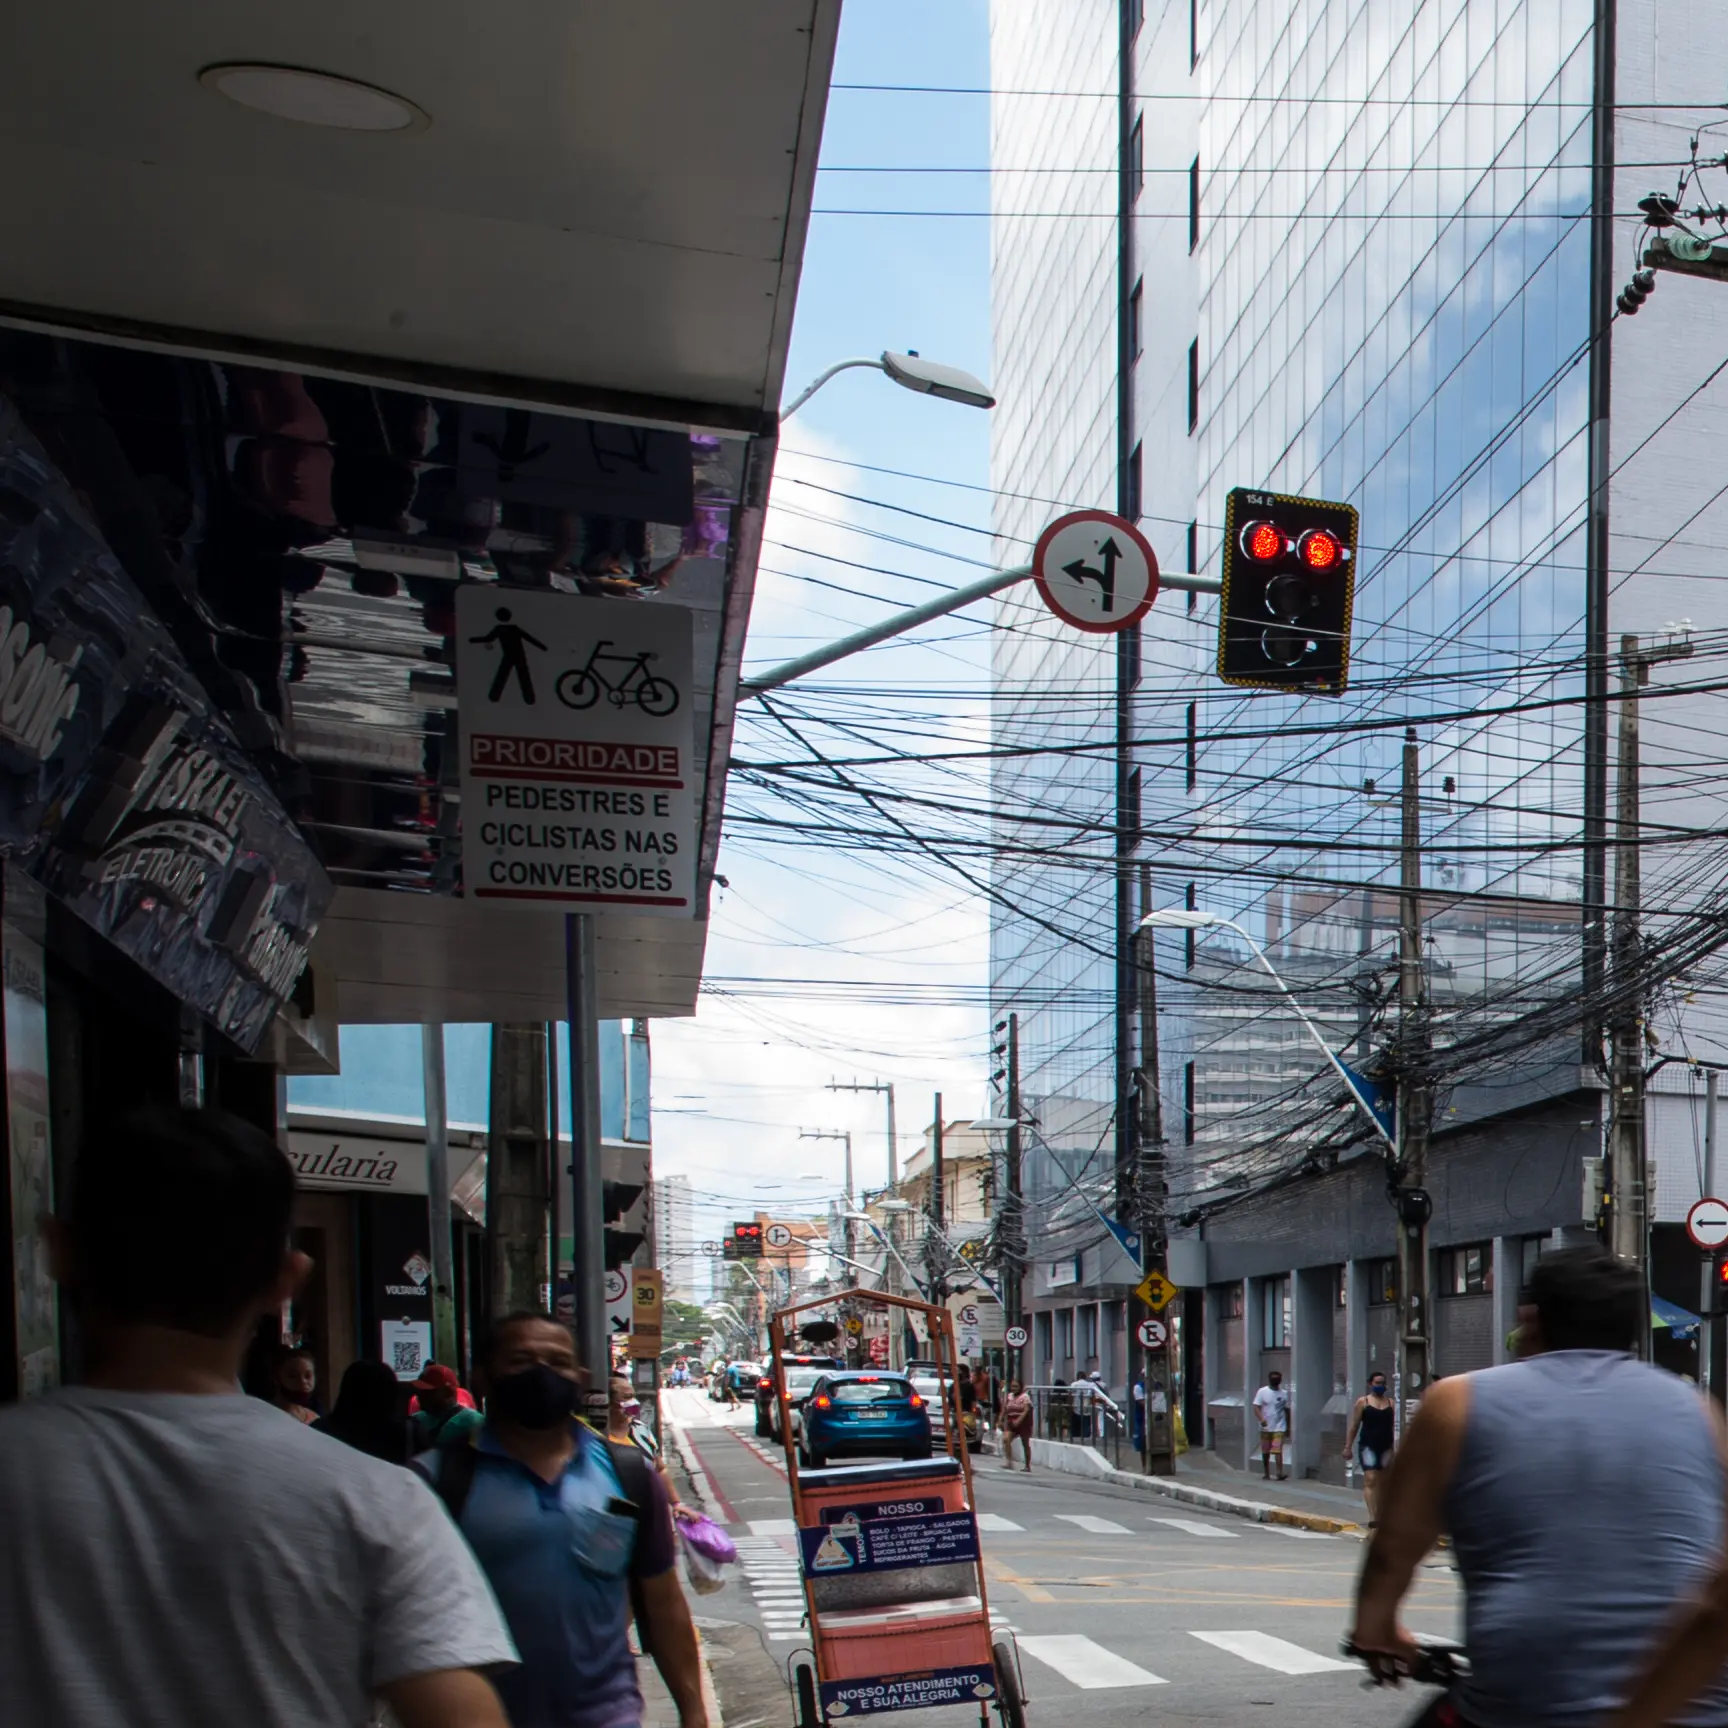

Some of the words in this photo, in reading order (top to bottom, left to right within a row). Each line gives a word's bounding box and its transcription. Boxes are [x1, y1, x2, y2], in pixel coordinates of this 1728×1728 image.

[1246, 494, 1263, 505] 154
[472, 738, 677, 773] PRIORIDADE
[487, 784, 645, 816] PEDESTRES
[654, 794, 670, 817] E
[480, 822, 617, 852] CICLISTAS
[625, 830, 678, 855] NAS
[490, 861, 672, 892] CONVERSÕES
[289, 1144, 398, 1181] ularia
[637, 1287, 655, 1301] 30
[1008, 1329, 1025, 1341] 30
[878, 1502, 924, 1516] NOSSO
[896, 1523, 926, 1533] TAPIOCA
[932, 1518, 971, 1529] SALGADOS
[856, 1533, 867, 1564] TEMOS
[837, 1685, 885, 1700] NOSSO
[887, 1674, 980, 1694] ATENDIMENTO
[860, 1698, 871, 1709] E
[873, 1696, 900, 1708] SUA
[902, 1688, 961, 1705] ALEGRIA
